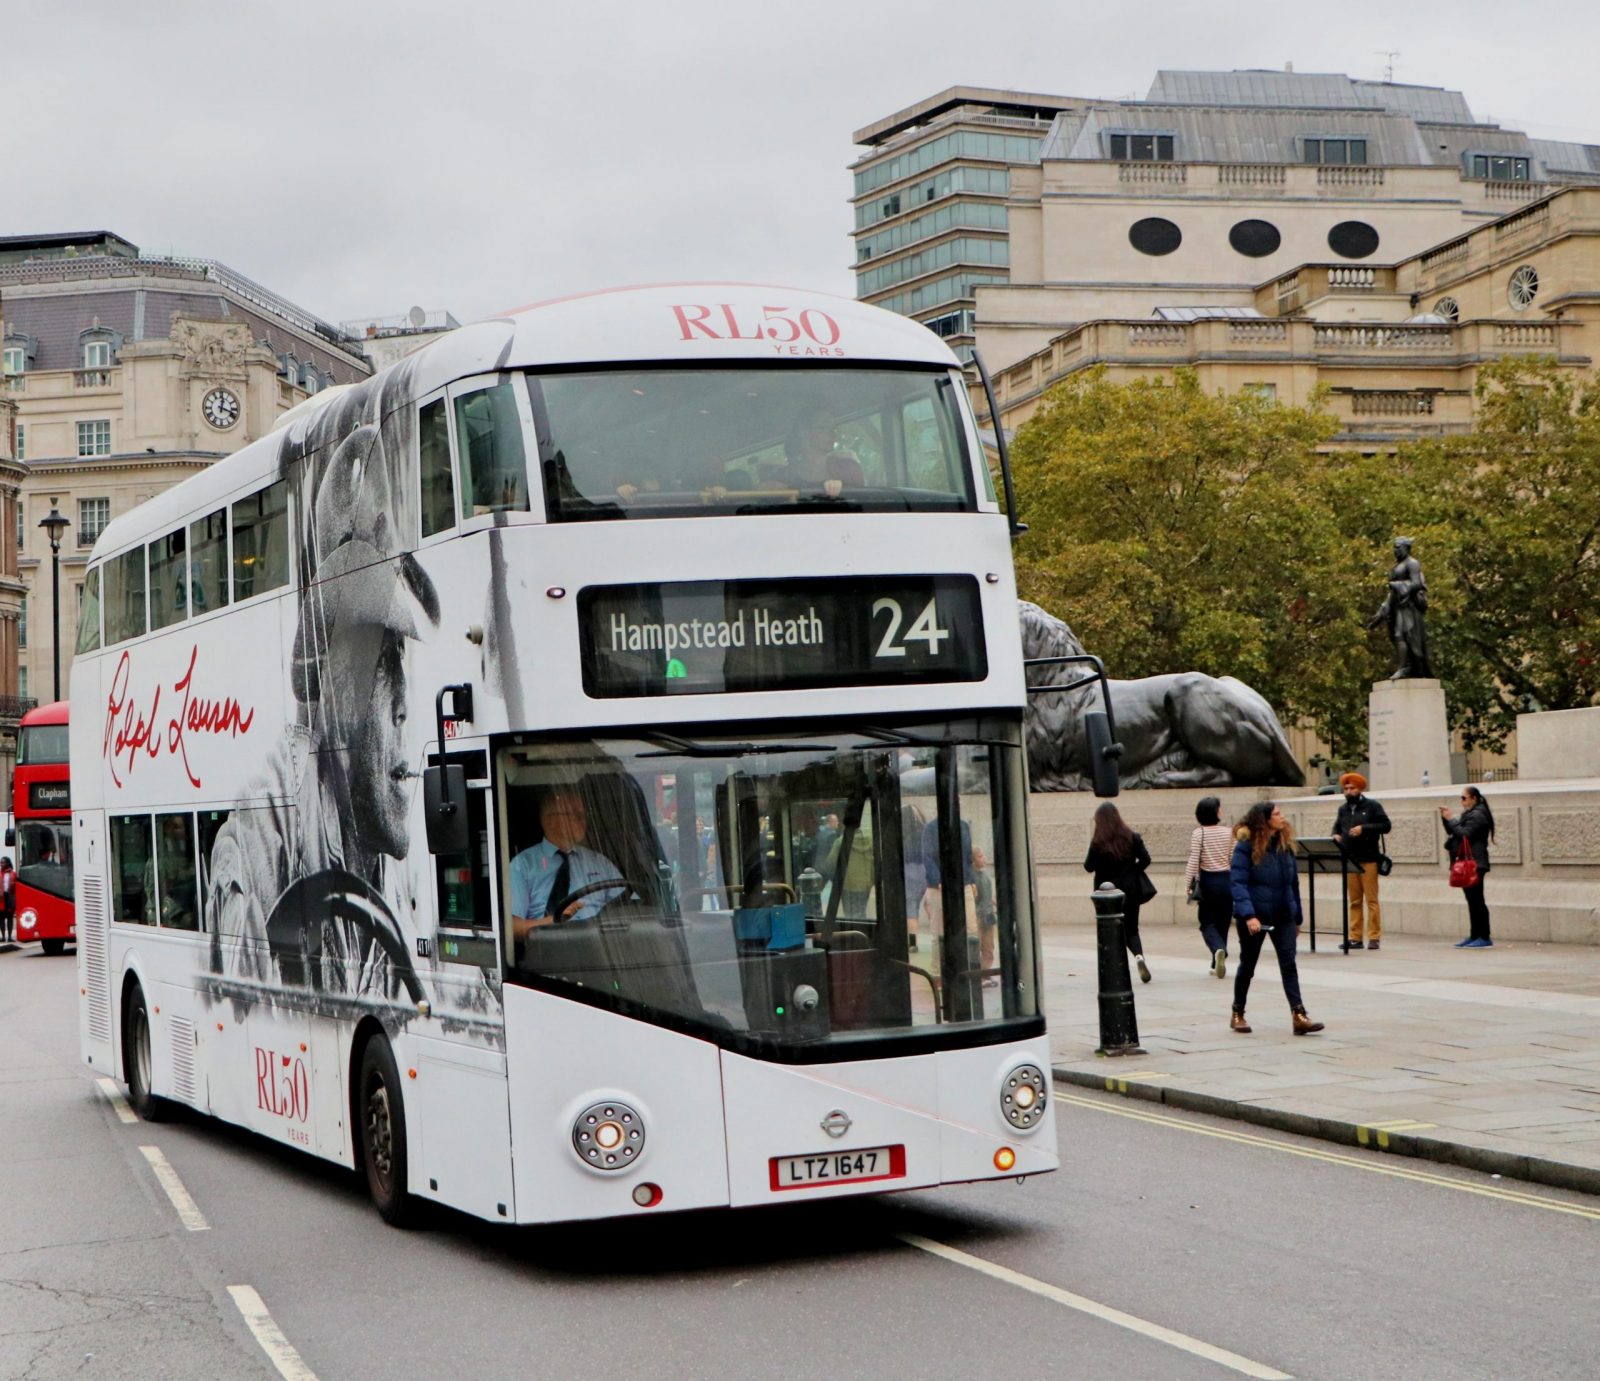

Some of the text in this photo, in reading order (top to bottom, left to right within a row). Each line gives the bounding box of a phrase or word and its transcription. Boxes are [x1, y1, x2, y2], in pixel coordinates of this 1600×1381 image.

[667, 303, 840, 346] RL50
[773, 345, 845, 357] YEARS
[610, 597, 949, 661] Hampstead Heath 24
[38, 787, 68, 801] Clapham
[255, 1046, 308, 1123] RL50
